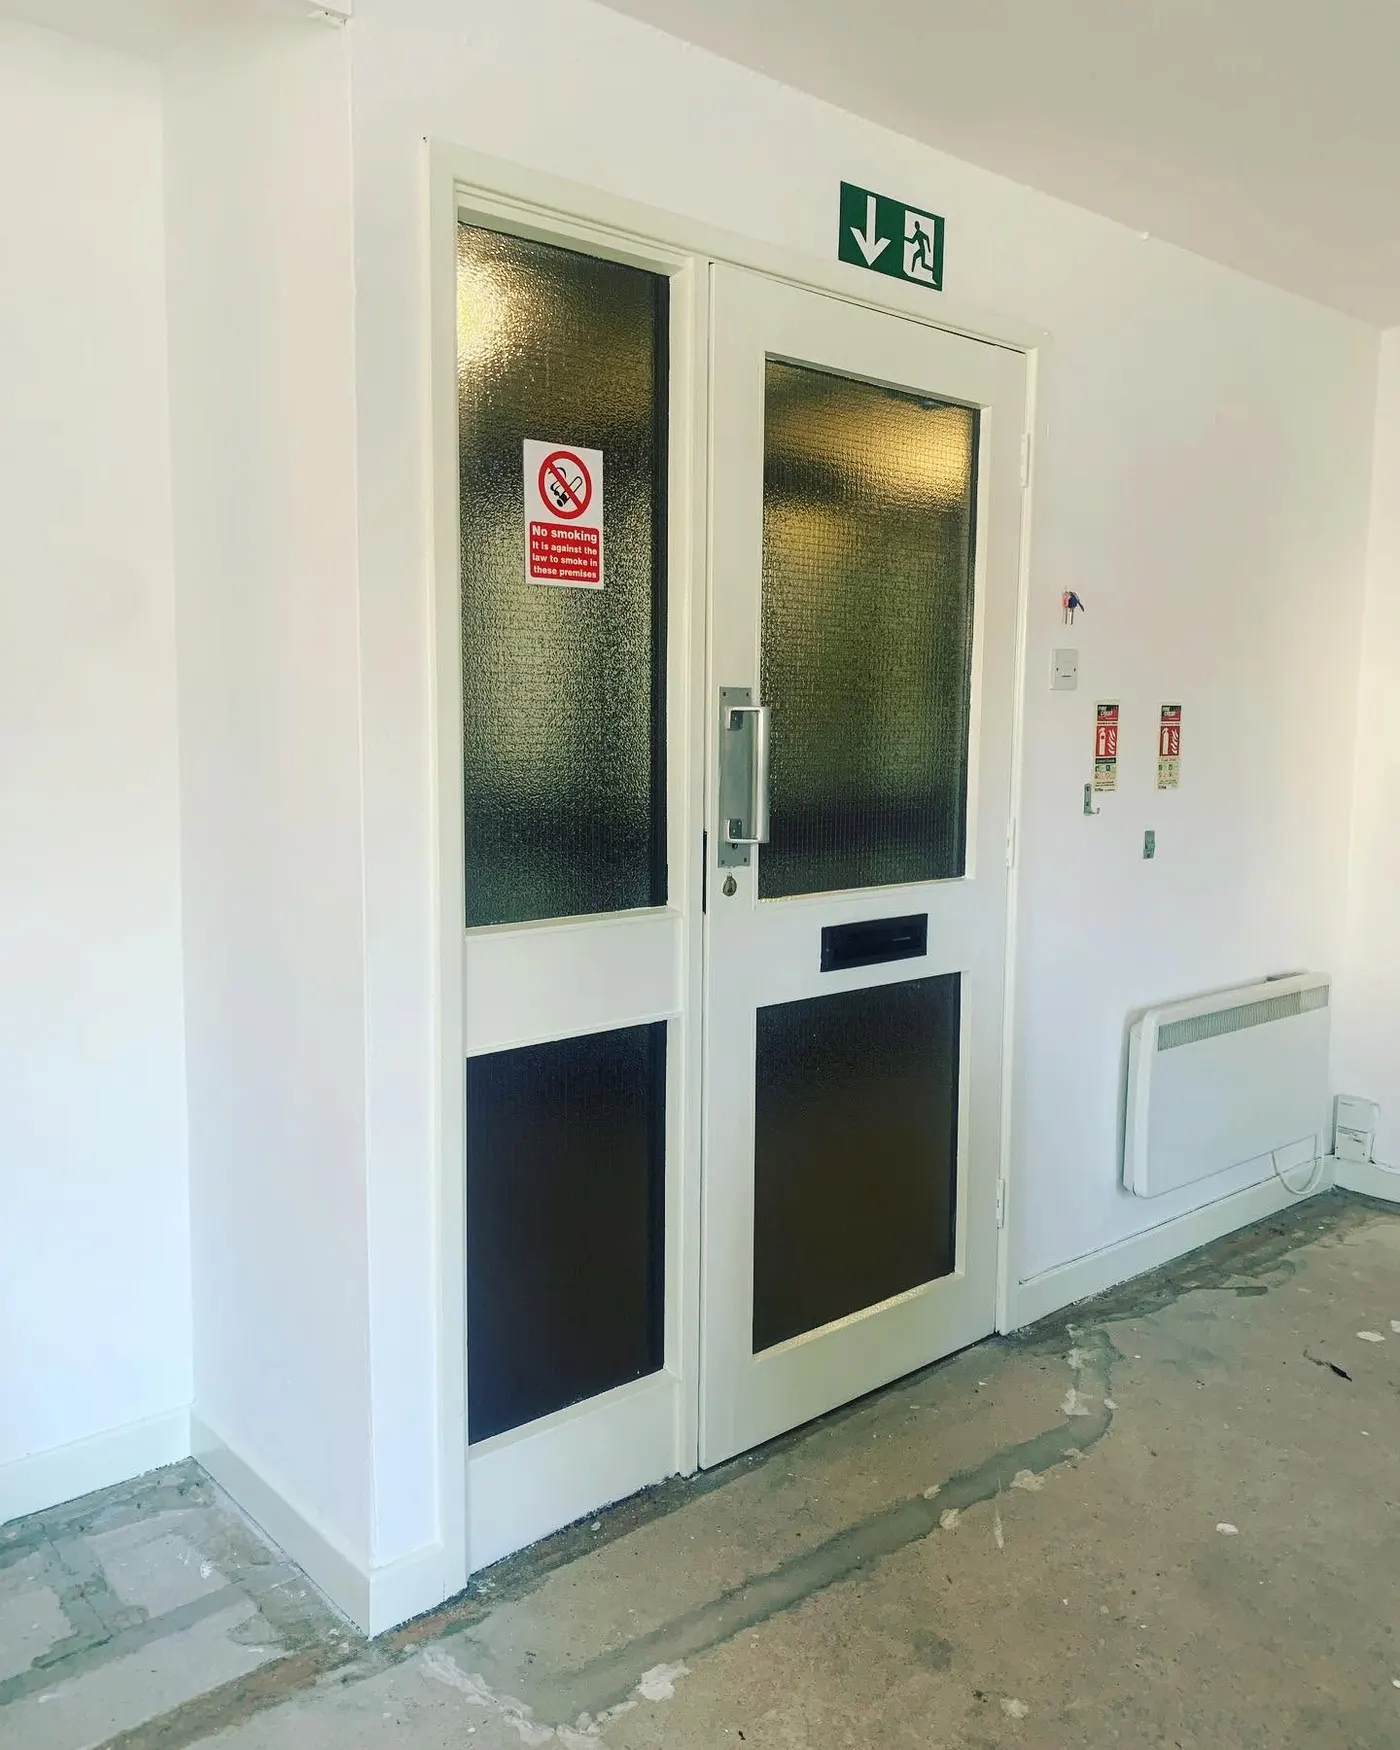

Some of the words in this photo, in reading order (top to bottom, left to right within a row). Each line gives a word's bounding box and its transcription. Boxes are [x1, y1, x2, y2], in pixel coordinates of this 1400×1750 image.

[532, 525, 548, 537] No
[551, 529, 597, 544] smoking
[532, 541, 539, 549] It
[541, 542, 549, 551] is
[551, 545, 582, 554] against
[584, 546, 597, 555] the
[532, 553, 548, 562] law
[549, 555, 559, 563] to
[561, 556, 588, 566] smoke
[590, 557, 597, 567] in
[533, 566, 557, 575] these
[559, 568, 597, 578] premises
